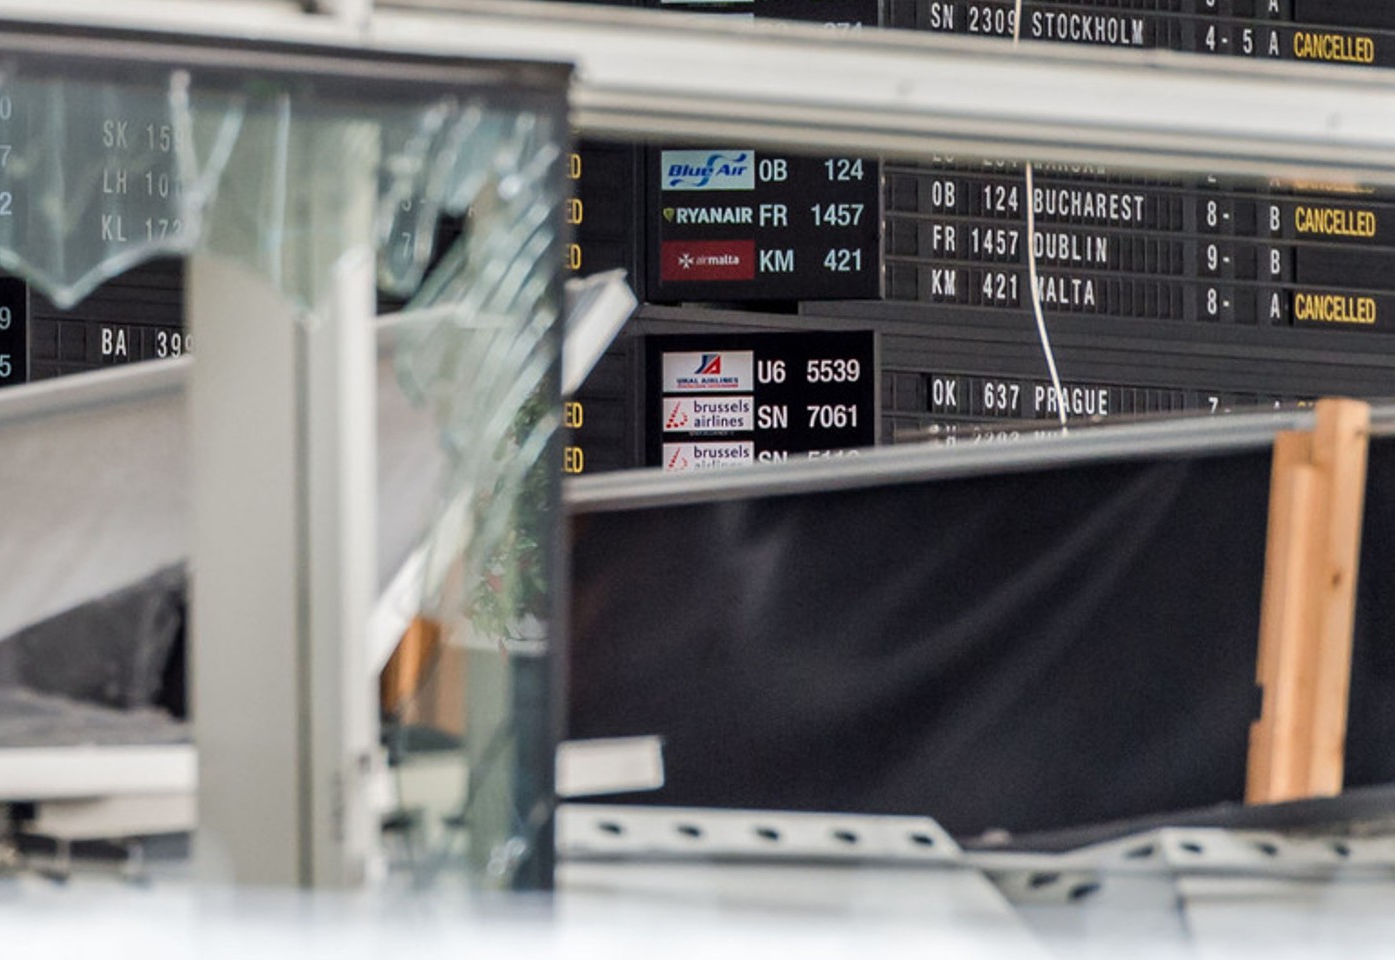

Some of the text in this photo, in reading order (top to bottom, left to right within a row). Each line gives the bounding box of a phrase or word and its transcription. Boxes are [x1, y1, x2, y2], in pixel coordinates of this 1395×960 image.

[1032, 12, 1374, 62] STOCKHOLM CANCELLED
[677, 207, 752, 223] RYANAIR
[760, 204, 863, 226] FR 1457
[932, 181, 1375, 236] OB 124 BUCHAREST CANCELLED
[760, 249, 860, 272] KM 421
[932, 270, 1376, 323] KM 421 CANCELLED
[758, 359, 860, 383] U6 5539
